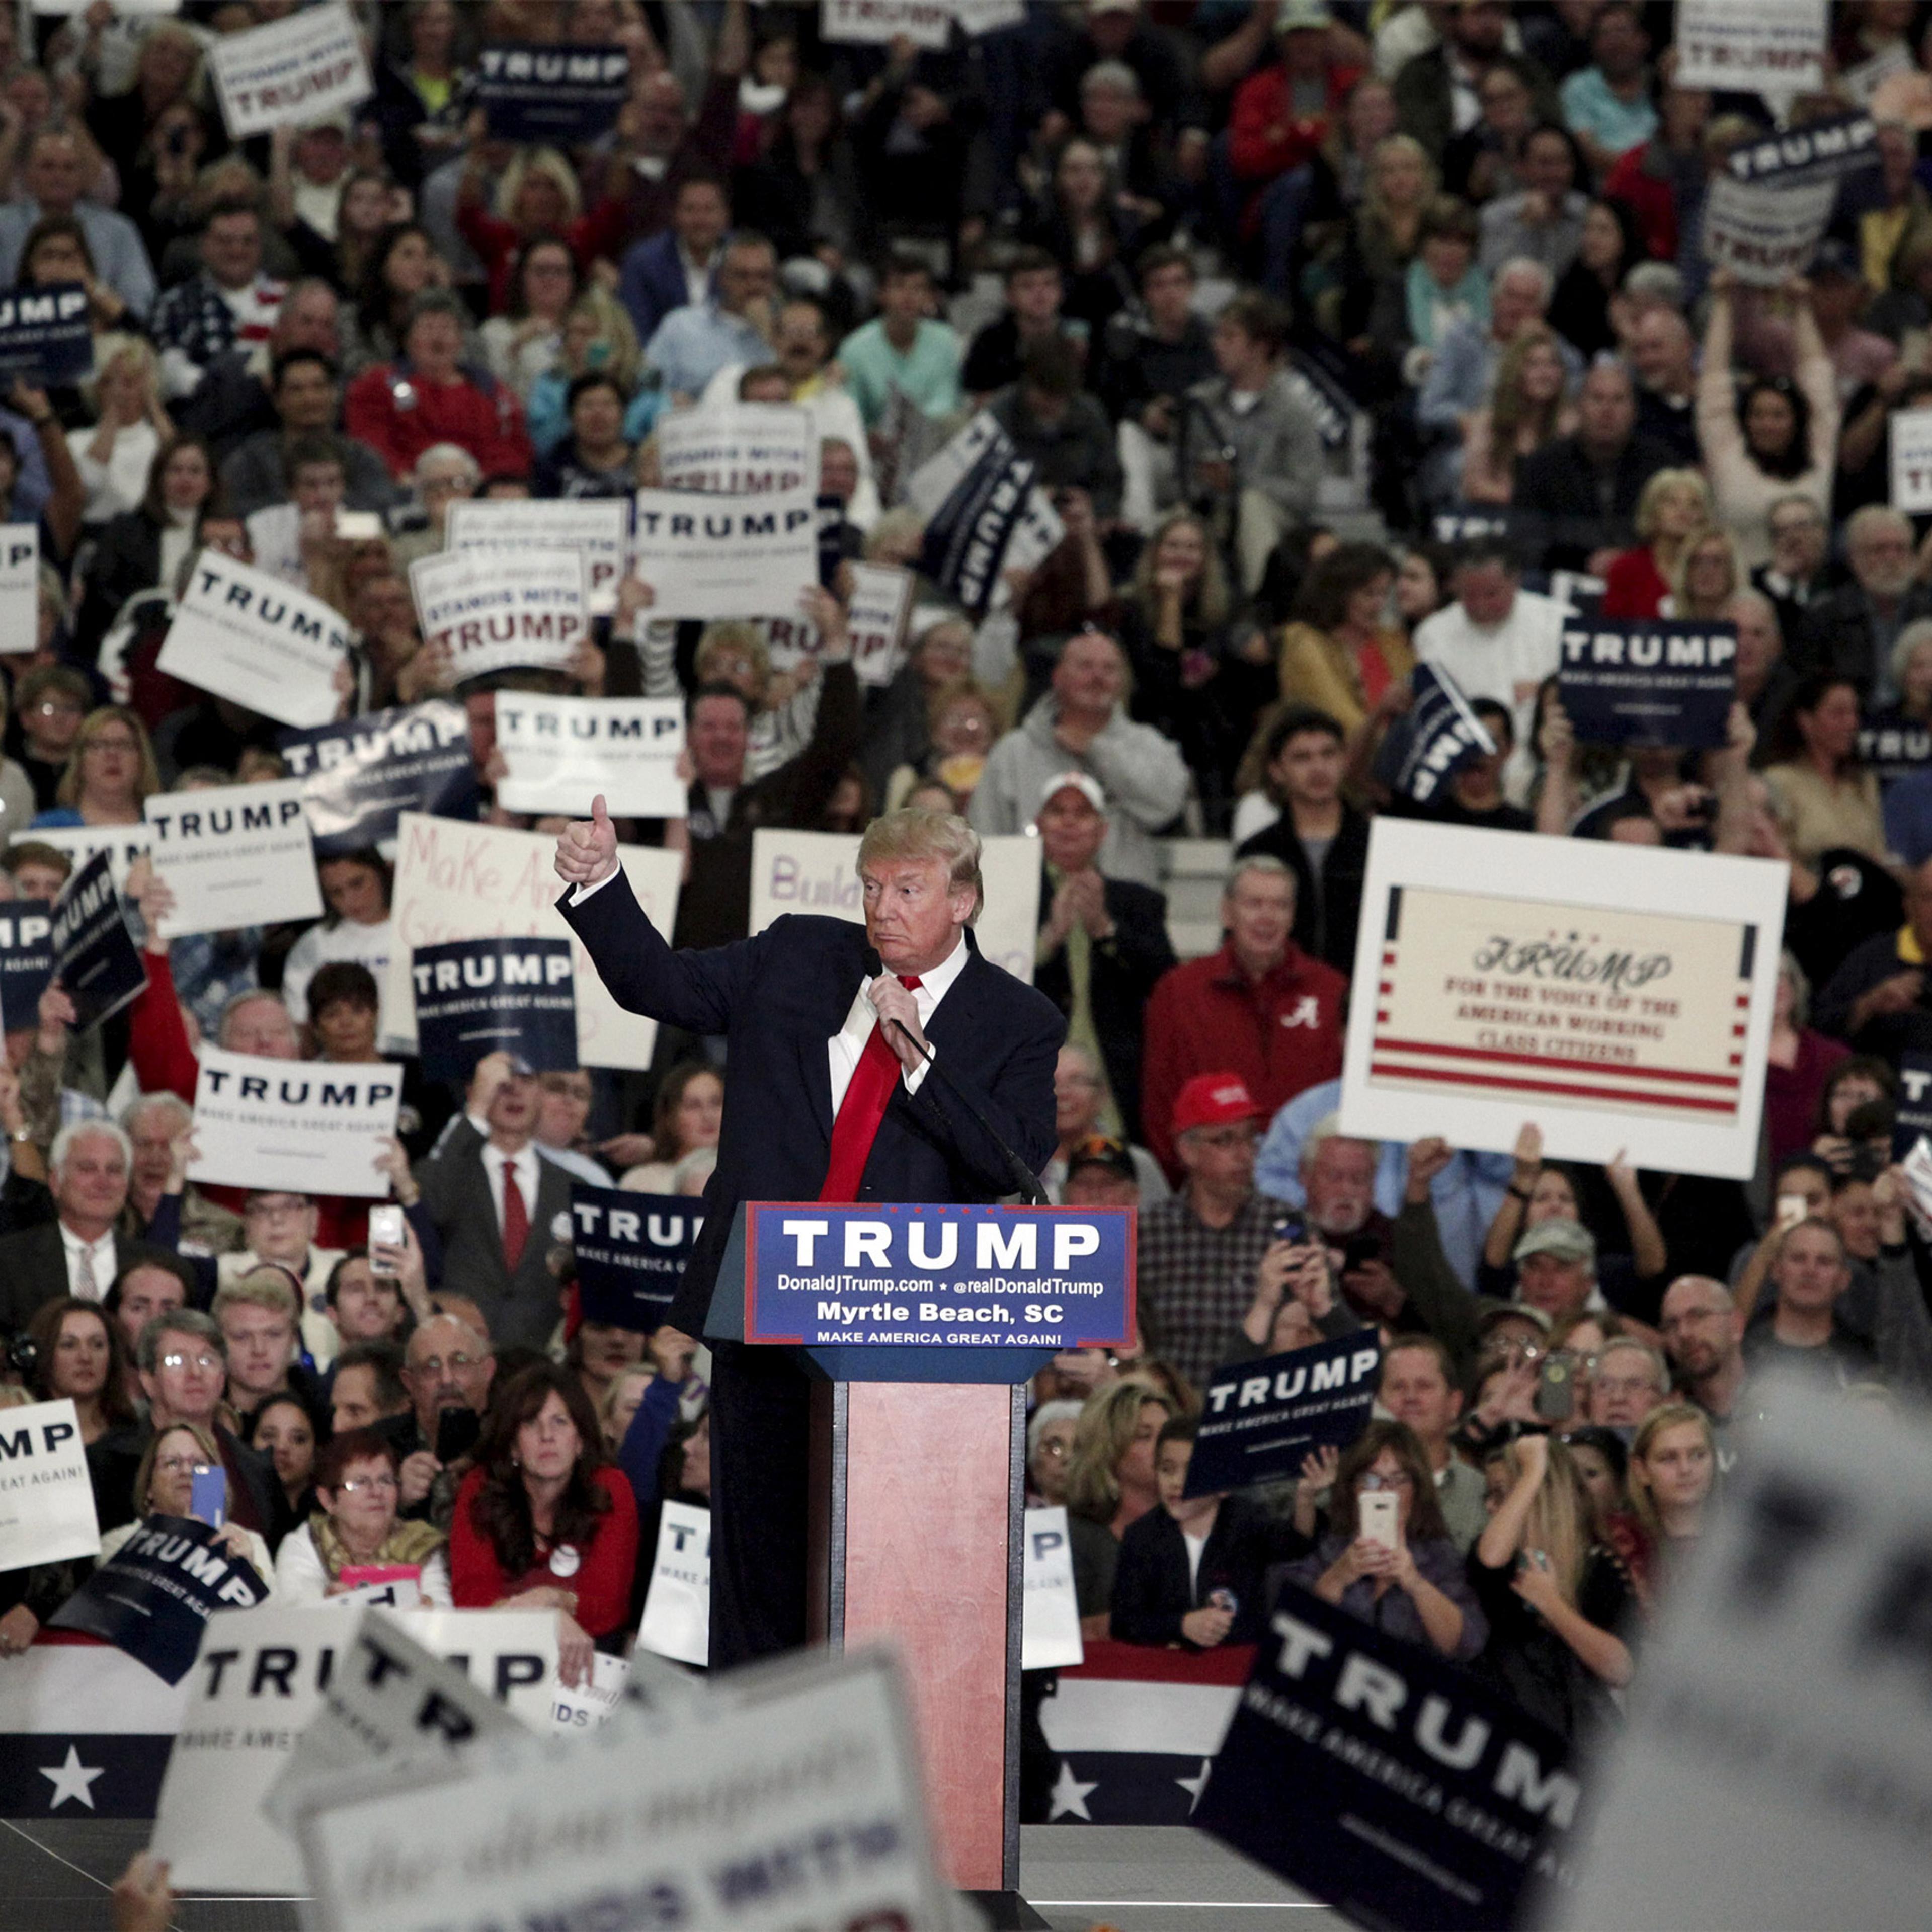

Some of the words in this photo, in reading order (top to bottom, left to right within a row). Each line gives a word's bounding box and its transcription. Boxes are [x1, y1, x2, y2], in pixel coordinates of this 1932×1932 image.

[480, 51, 629, 82] TRUMP
[1729, 119, 1877, 180] TRUMP
[645, 510, 809, 539] TRUMP
[1562, 631, 1735, 667] TRUMP
[503, 710, 677, 738] TRUMP
[153, 801, 301, 840] TRUMP
[413, 954, 573, 995] TRUMP
[1445, 976, 1486, 996] FOR
[1493, 982, 1532, 1001] THE
[1540, 987, 1598, 1007] VOICE
[1607, 994, 1632, 1010] OF
[1641, 997, 1681, 1017] THE
[1456, 1004, 1561, 1027] AMERICAN
[1568, 1014, 1664, 1040] WORKING
[1478, 1030, 1538, 1051] CLASS
[1545, 1038, 1638, 1063] CITIZENS
[206, 1069, 394, 1106] TRUMP
[576, 1245, 609, 1265] MAKE
[613, 1250, 672, 1273] AMERICA
[783, 1220, 1101, 1270] TRUMP
[778, 1274, 933, 1294] DonaldJTrump.com
[954, 1278, 1104, 1298] @realDonaldTrump
[817, 1302, 910, 1325] Myrtle
[919, 1303, 1016, 1325] Beach,
[1024, 1304, 1064, 1323] SC
[817, 1332, 864, 1343] MAKE
[868, 1332, 942, 1344] AMERICA
[947, 1333, 1002, 1345] GREAT
[1006, 1333, 1062, 1345] AGAIN!
[1209, 1348, 1379, 1412] TRUMP
[32, 1466, 83, 1485] AGAIN!
[125, 1528, 256, 1608] TRUMP
